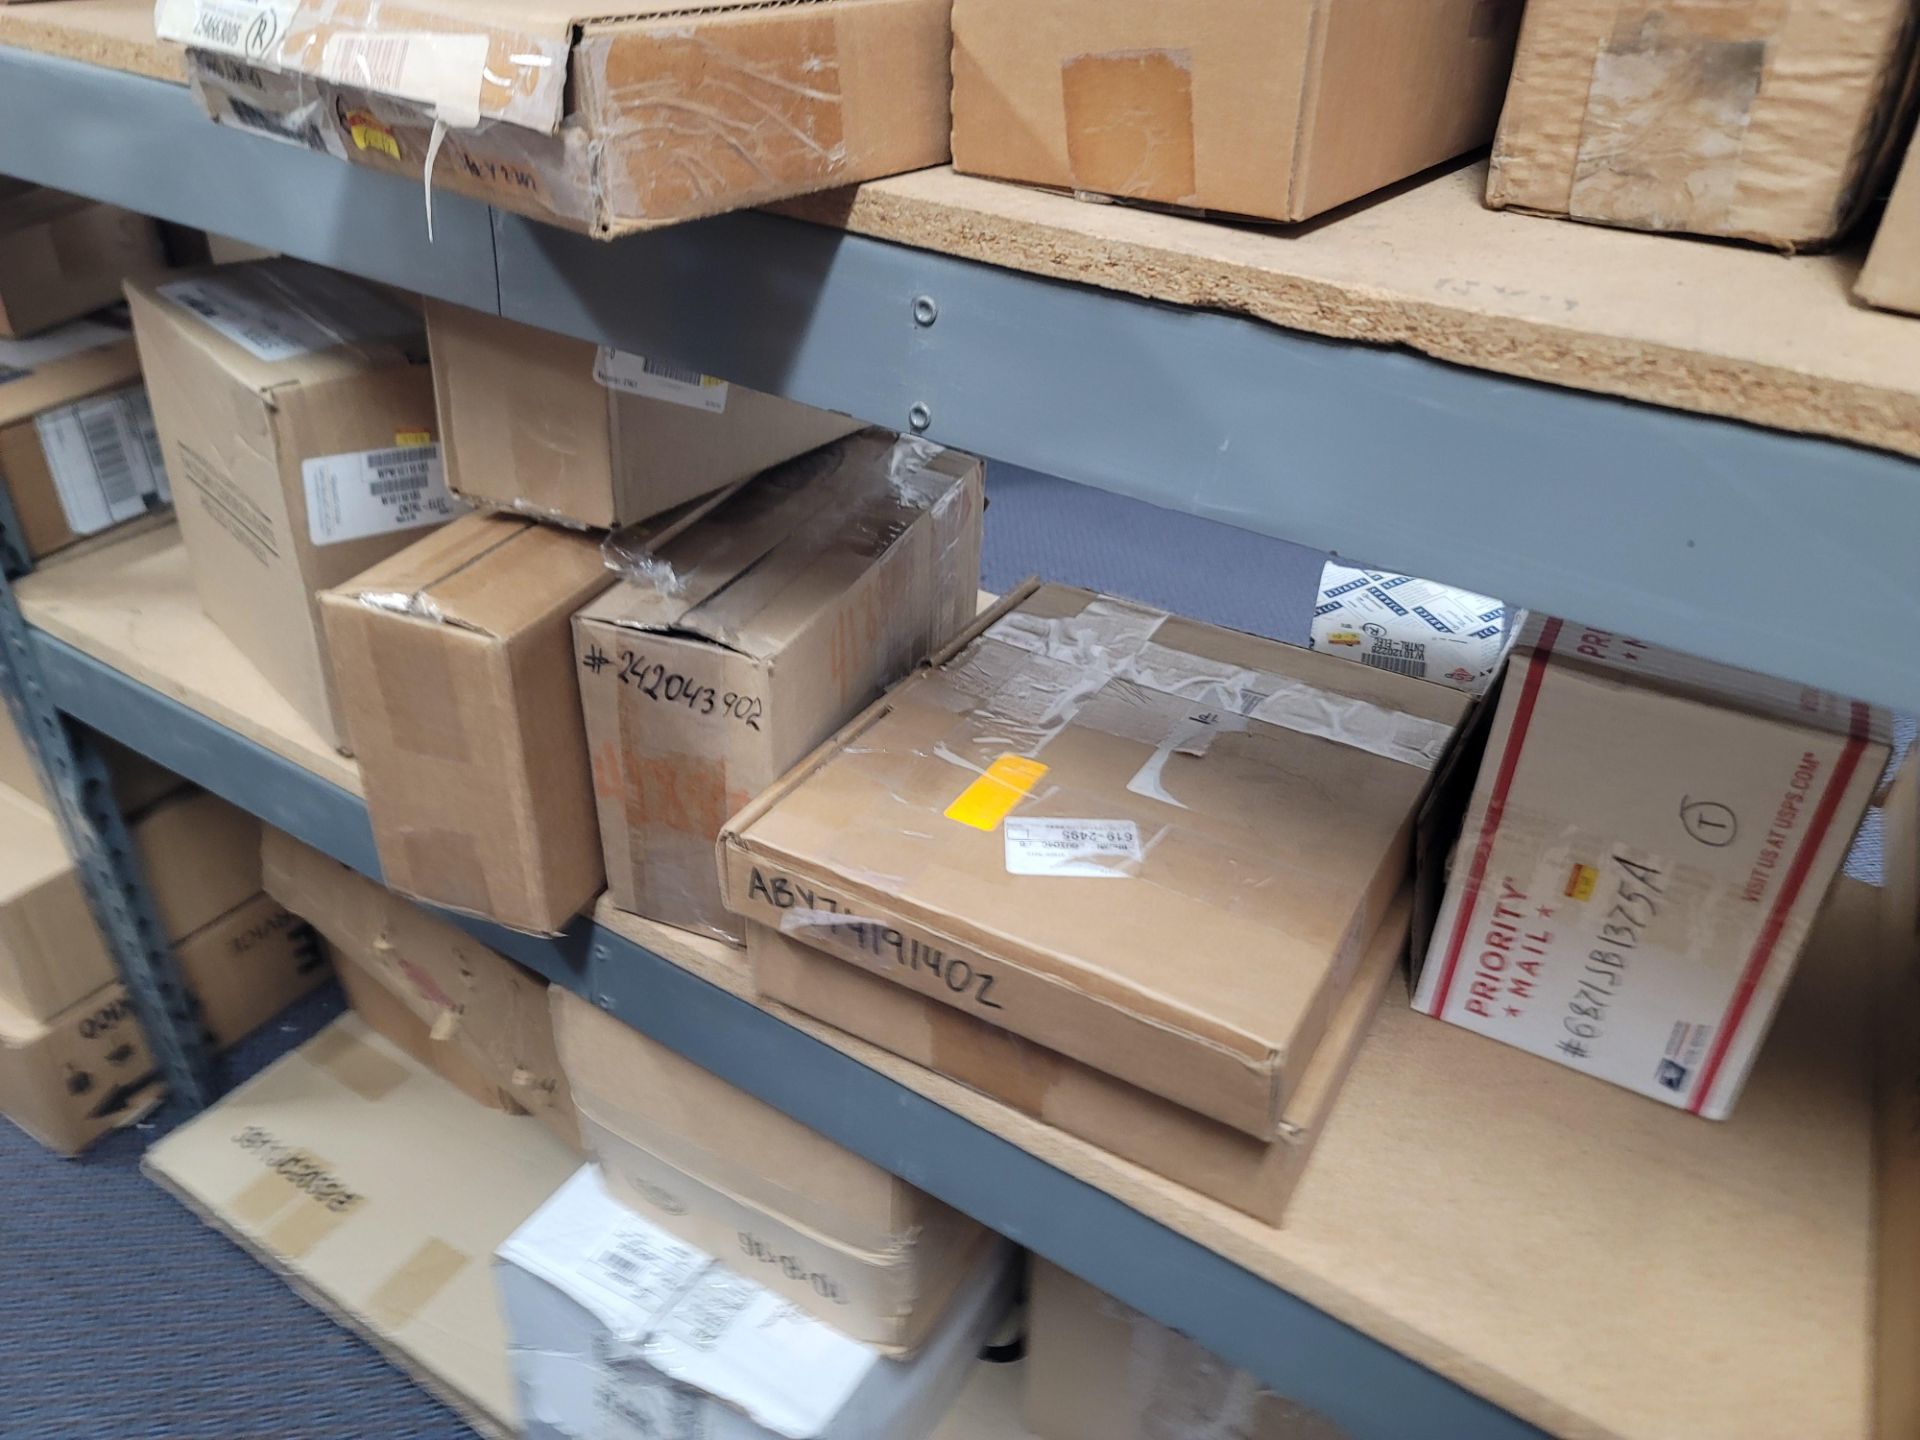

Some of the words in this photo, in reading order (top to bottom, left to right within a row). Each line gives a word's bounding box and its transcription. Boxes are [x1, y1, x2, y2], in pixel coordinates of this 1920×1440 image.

[252, 17, 267, 49] R
[1766, 829, 1787, 850] AT
[1756, 848, 1780, 869] US
[1741, 867, 1770, 903] VISIT
[1465, 880, 1528, 1018] PRIORITY
[1507, 931, 1552, 998] MAIL
